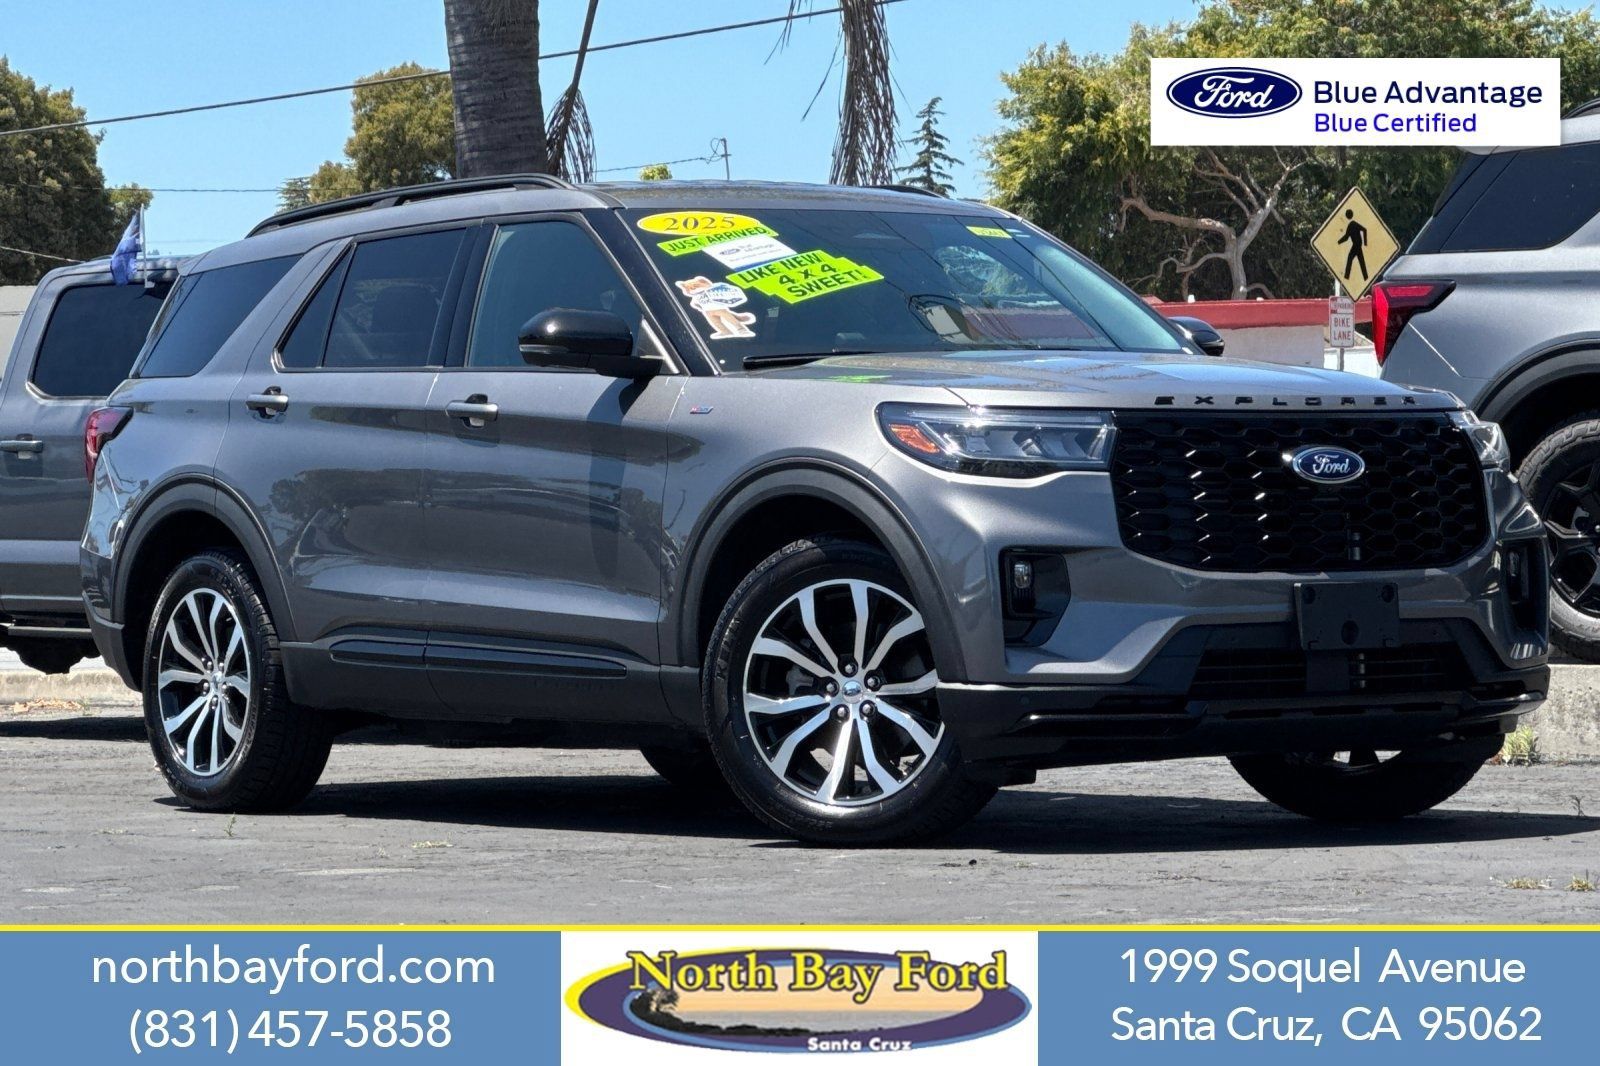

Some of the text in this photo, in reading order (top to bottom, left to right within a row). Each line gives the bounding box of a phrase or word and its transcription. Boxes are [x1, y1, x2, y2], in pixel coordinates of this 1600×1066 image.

[663, 216, 736, 231] 2025
[668, 237, 702, 252] JUST
[738, 264, 780, 283] LIKE
[780, 252, 823, 270] NEW
[778, 274, 796, 285] 4
[820, 263, 837, 273] 4
[787, 269, 868, 297] SWEET!
[1333, 317, 1351, 328] BIKE
[1333, 330, 1352, 341] LANE
[1154, 395, 1417, 406] EXPLORER
[1312, 453, 1351, 474] Ford
